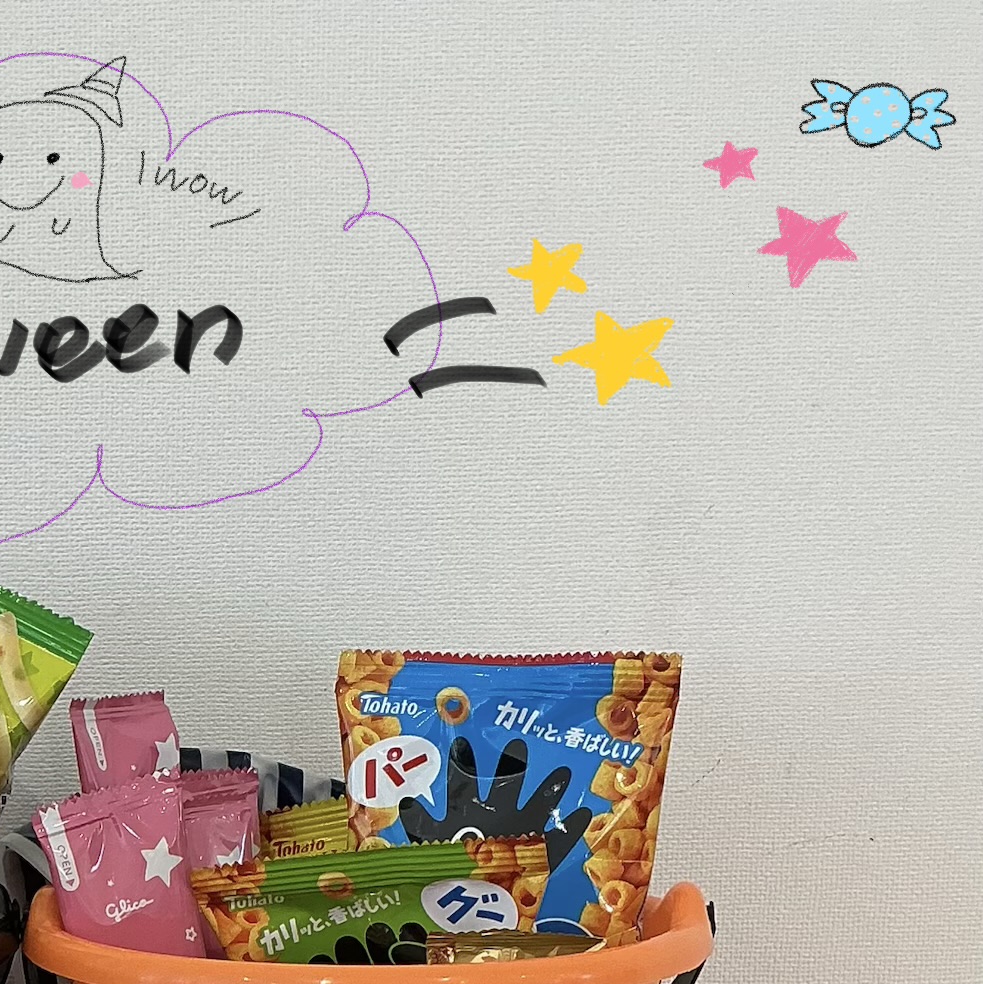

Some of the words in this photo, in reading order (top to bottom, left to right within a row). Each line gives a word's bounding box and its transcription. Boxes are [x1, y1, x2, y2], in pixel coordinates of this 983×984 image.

[360, 693, 419, 716] Tohato
[90, 727, 103, 757] OPEN
[364, 746, 429, 800] パー
[57, 844, 73, 877] OPEN
[272, 839, 326, 858] Tohato
[105, 898, 155, 923] Glico
[436, 885, 506, 925] グー
